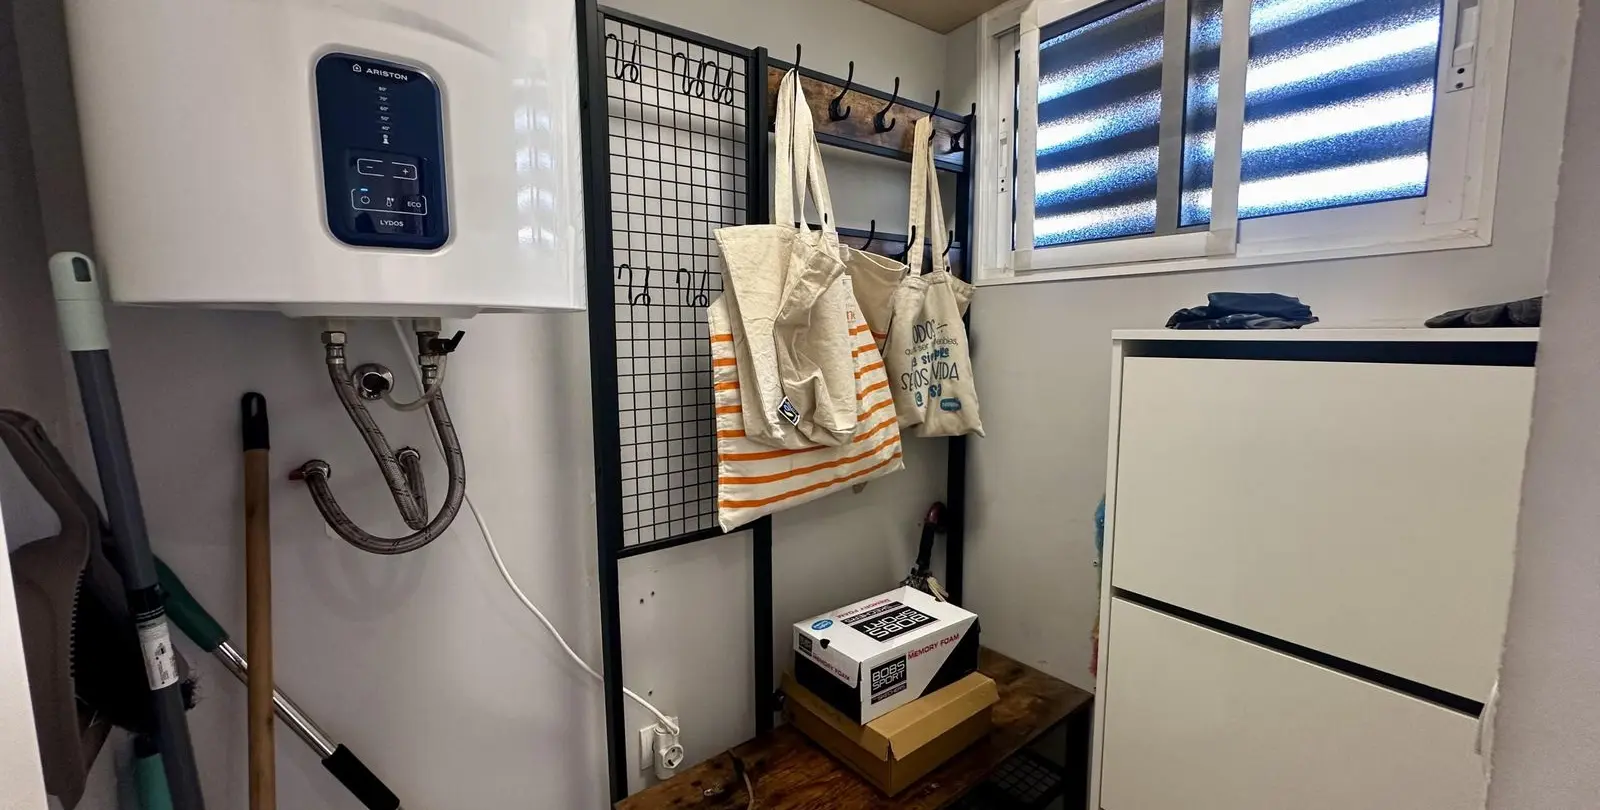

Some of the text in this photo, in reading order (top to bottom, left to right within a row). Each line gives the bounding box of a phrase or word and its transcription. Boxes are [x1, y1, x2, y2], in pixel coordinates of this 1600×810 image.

[366, 68, 408, 81] ARISTON
[407, 200, 422, 208] ECO
[380, 219, 404, 227] LYDOS
[931, 360, 960, 381] VIDA
[863, 608, 918, 633] SPORT
[868, 613, 930, 639] BOBS
[907, 633, 960, 660] MEMORY FOAM
[872, 660, 906, 682] BOBS
[872, 670, 905, 691] SPORT
